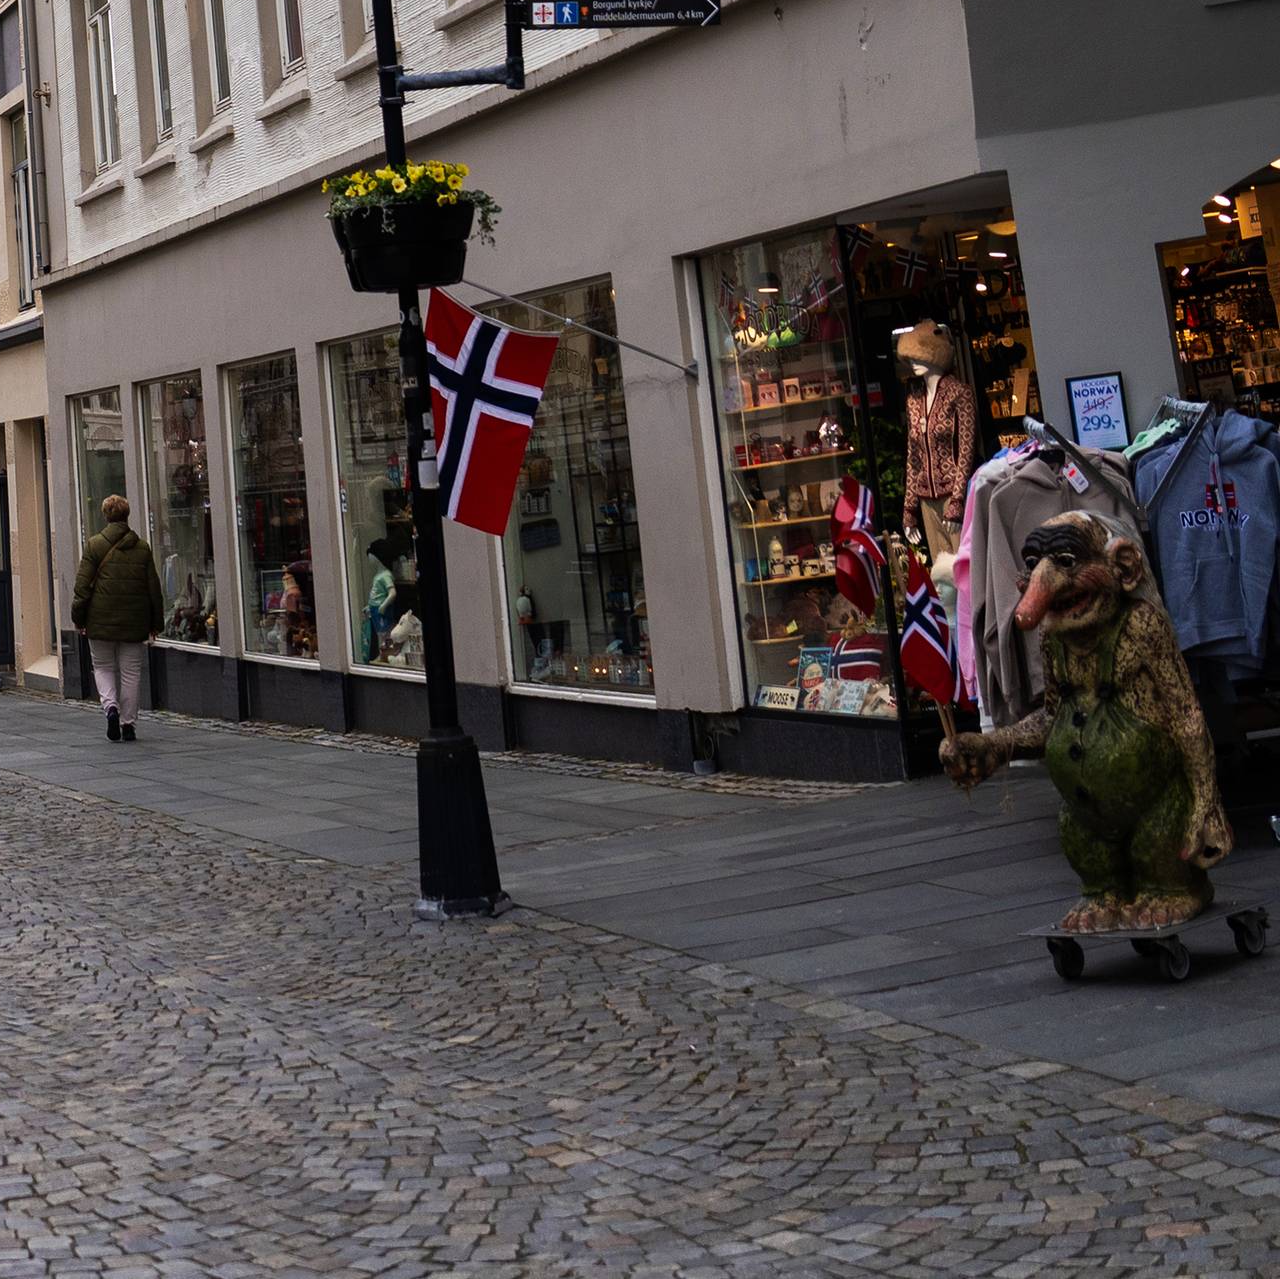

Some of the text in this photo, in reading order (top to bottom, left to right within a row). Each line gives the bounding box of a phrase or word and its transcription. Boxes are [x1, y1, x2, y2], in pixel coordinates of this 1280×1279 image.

[592, 0, 626, 10] Borgund
[592, 10, 674, 22] middelaldermuseum
[1073, 384, 1118, 399] NORWAY
[1081, 413, 1121, 432] 299,-
[768, 690, 790, 706] MOOSE
